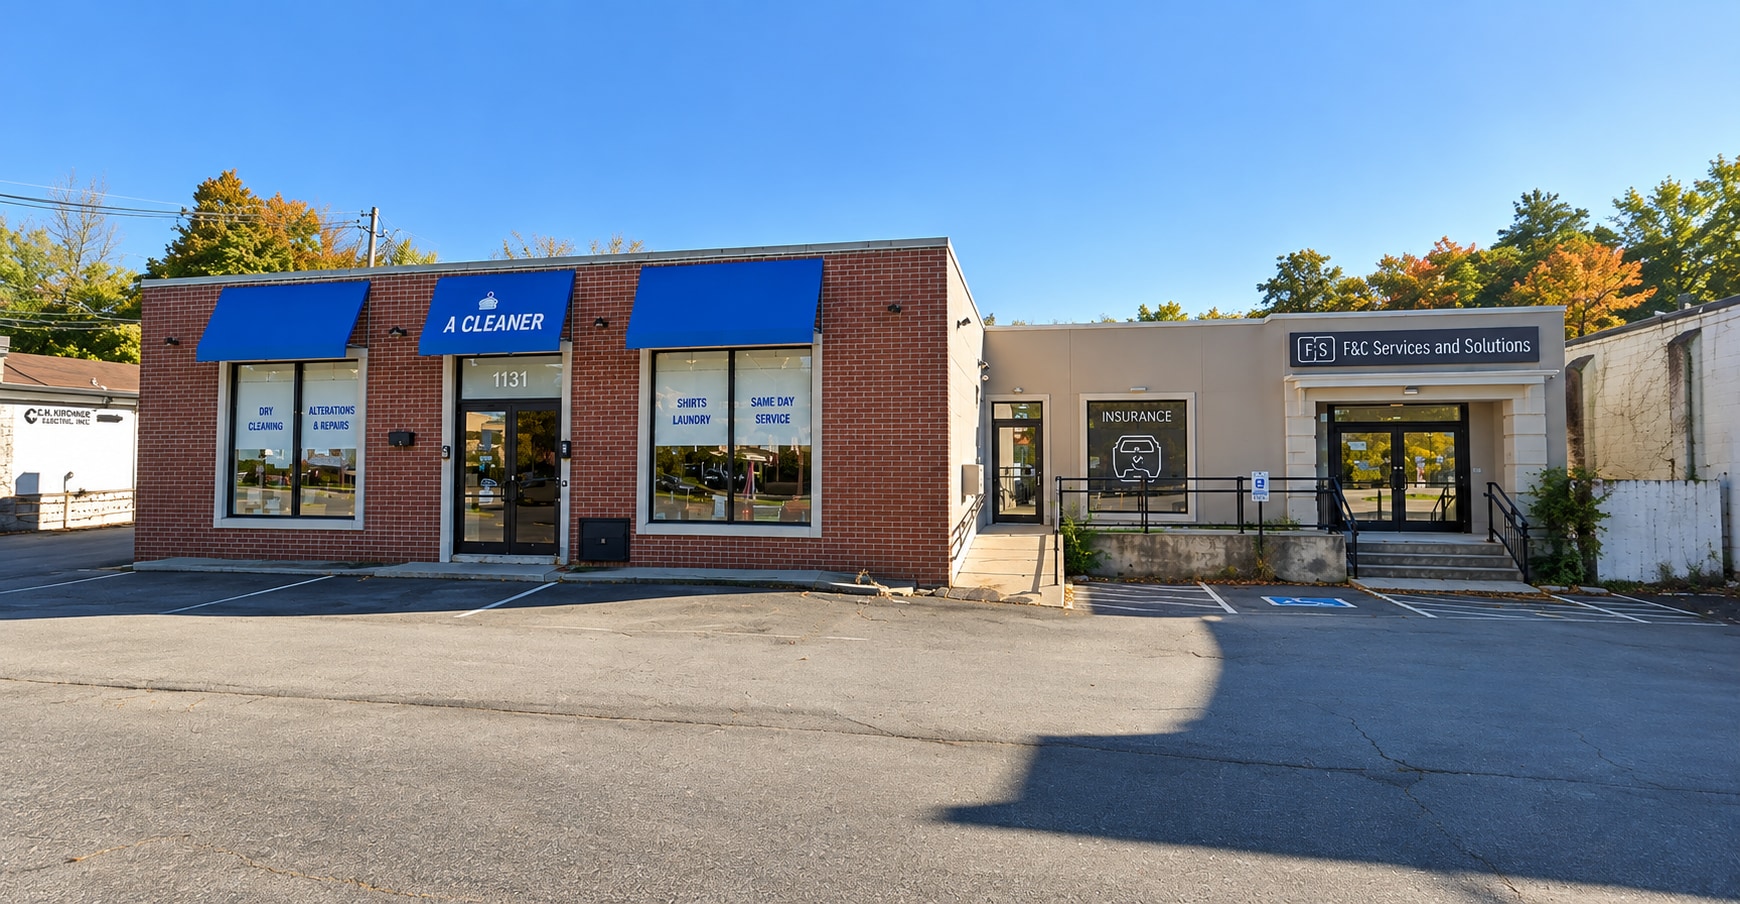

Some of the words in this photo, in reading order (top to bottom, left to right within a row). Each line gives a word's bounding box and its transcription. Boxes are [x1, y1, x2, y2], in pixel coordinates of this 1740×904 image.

[442, 316, 456, 333] A
[461, 313, 545, 333] CLEANER
[1343, 341, 1369, 356] F&C
[1373, 340, 1431, 356] Services
[1435, 338, 1460, 354] and
[1464, 337, 1531, 354] Solutions
[492, 370, 527, 388] 1131
[677, 397, 708, 408] SHIRTS
[750, 396, 775, 407] SAME
[777, 396, 795, 407] DAY
[259, 406, 274, 416] DRY
[308, 405, 355, 415] ALTERATIONS
[672, 414, 711, 425] LAUNDRY
[755, 413, 791, 424] SERVICE
[1102, 410, 1172, 422] INSURANCE
[248, 422, 283, 431] CLEANING
[313, 421, 319, 430] &
[320, 421, 350, 430] REPAIRS
